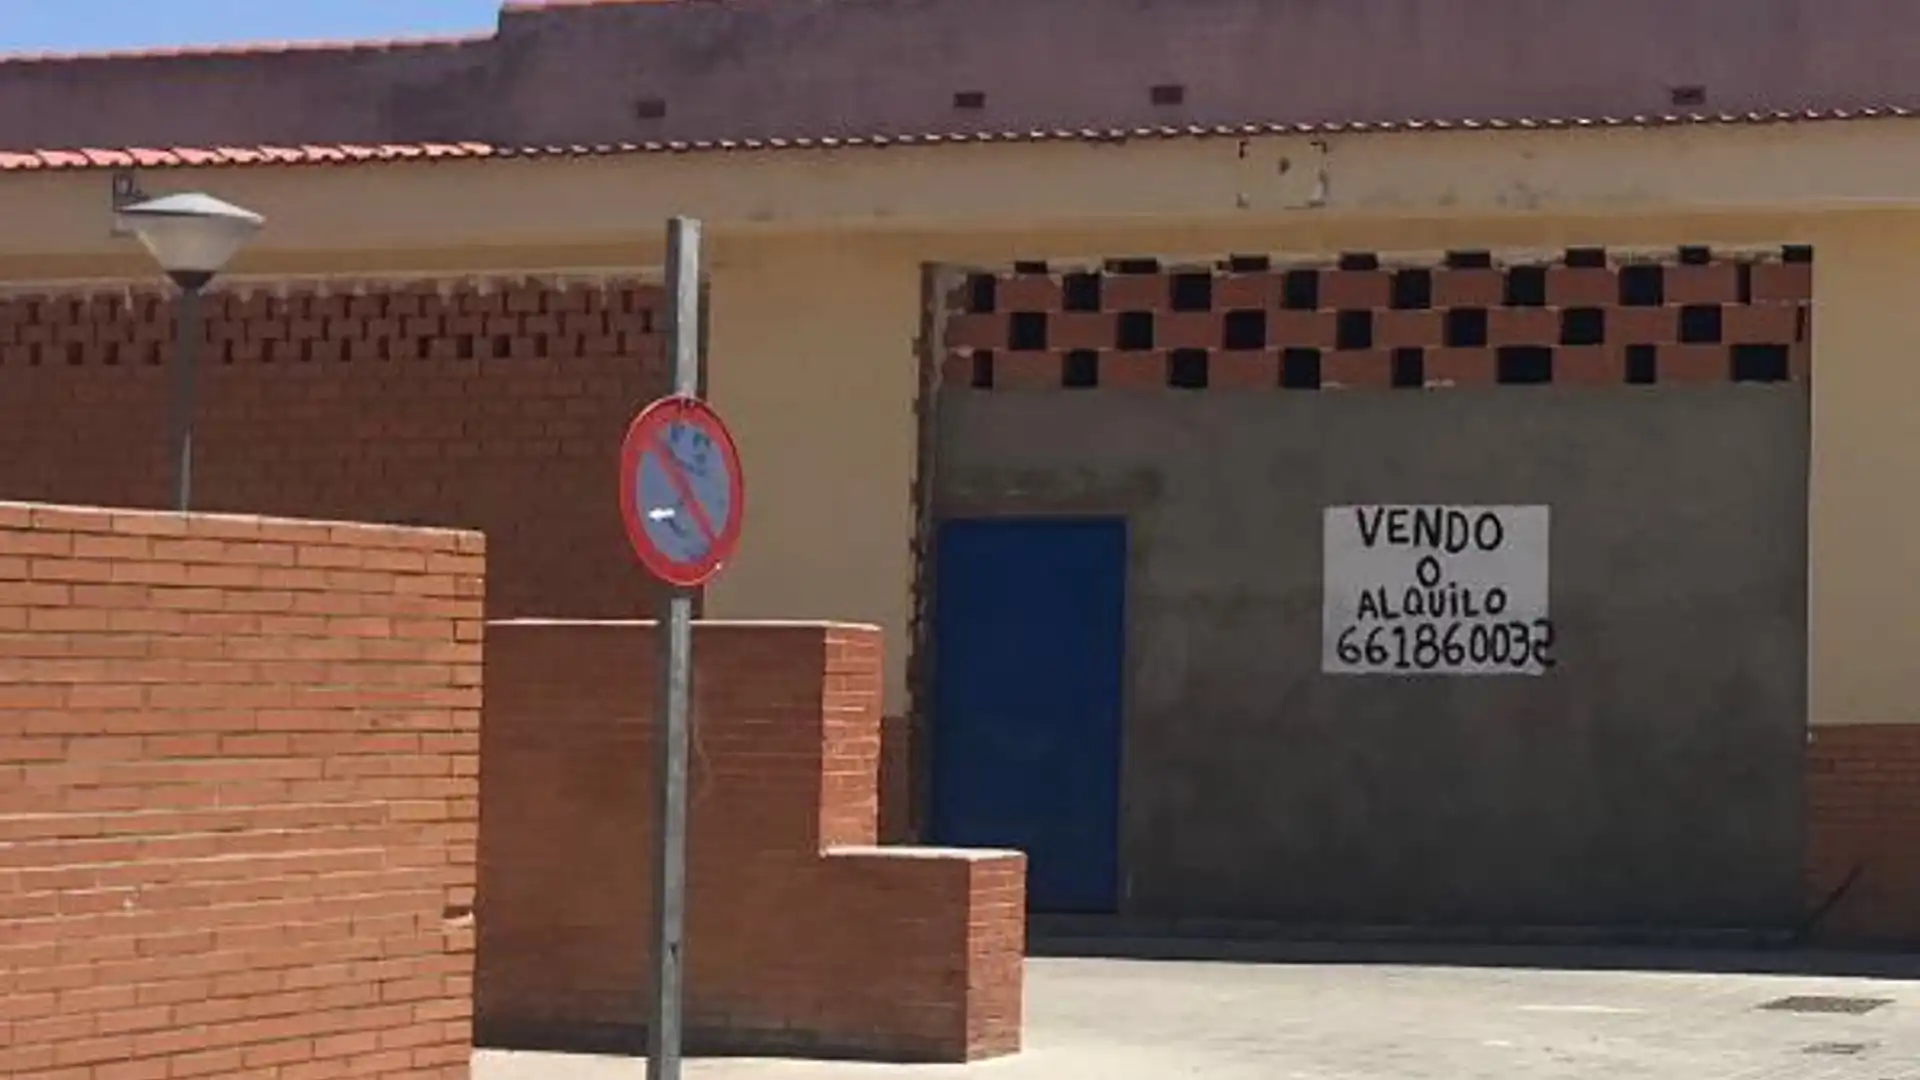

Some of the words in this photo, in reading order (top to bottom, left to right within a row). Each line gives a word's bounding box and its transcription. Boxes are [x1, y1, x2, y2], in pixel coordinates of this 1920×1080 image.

[1357, 508, 1503, 553] VENDO
[1416, 555, 1441, 586] O
[1337, 620, 1557, 669] 661860032
